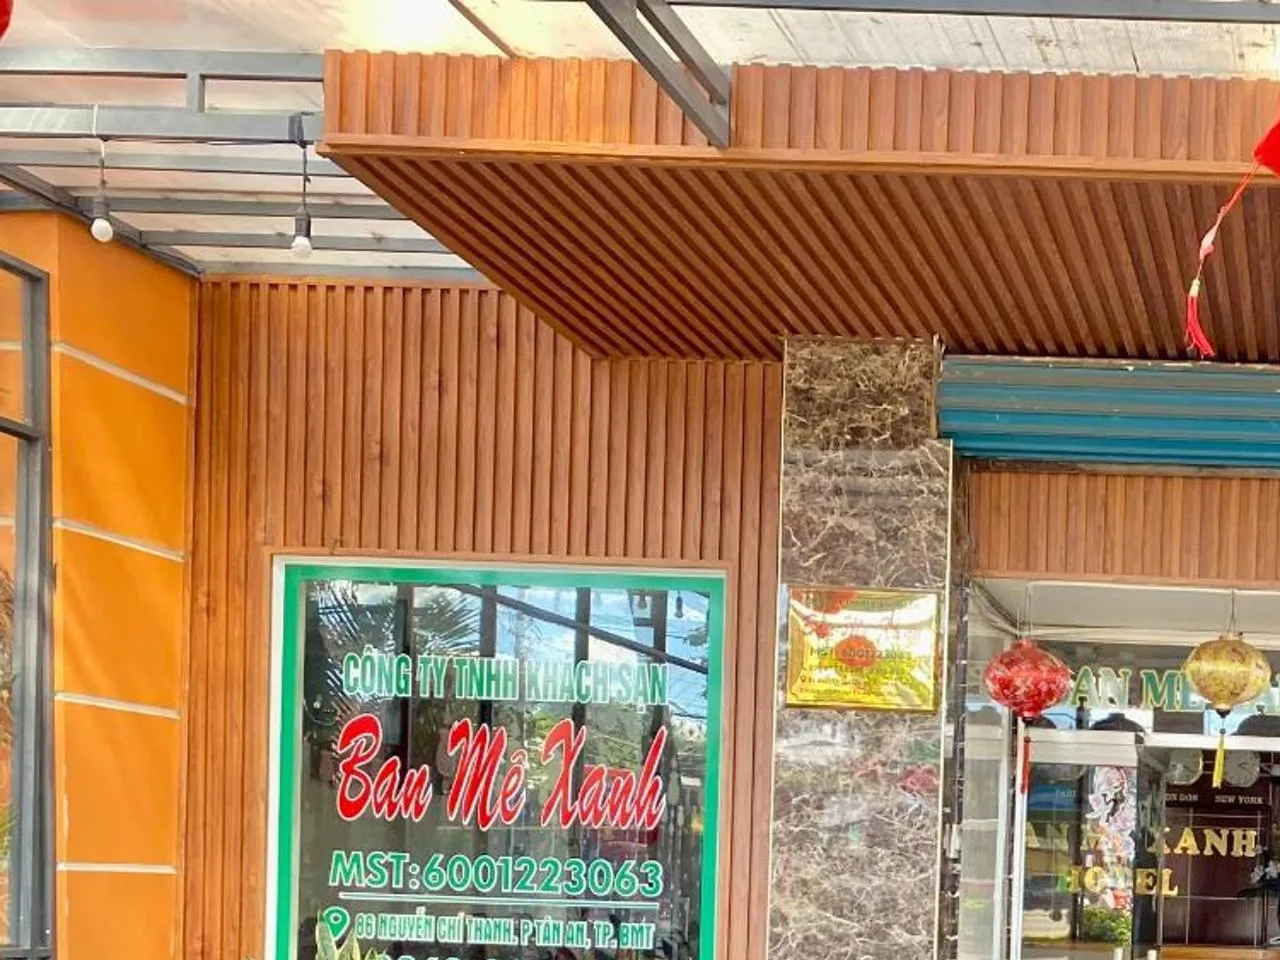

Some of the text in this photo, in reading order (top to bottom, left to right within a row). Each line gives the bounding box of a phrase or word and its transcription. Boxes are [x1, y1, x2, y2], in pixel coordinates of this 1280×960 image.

[342, 645, 412, 698] CÔNG
[418, 655, 448, 700] TY
[453, 656, 520, 701] TNHH
[619, 661, 670, 713] SẠN
[1068, 665, 1132, 709] AN
[336, 712, 668, 831] Ban Mê Xanh
[328, 849, 664, 898] MST:6001223063
